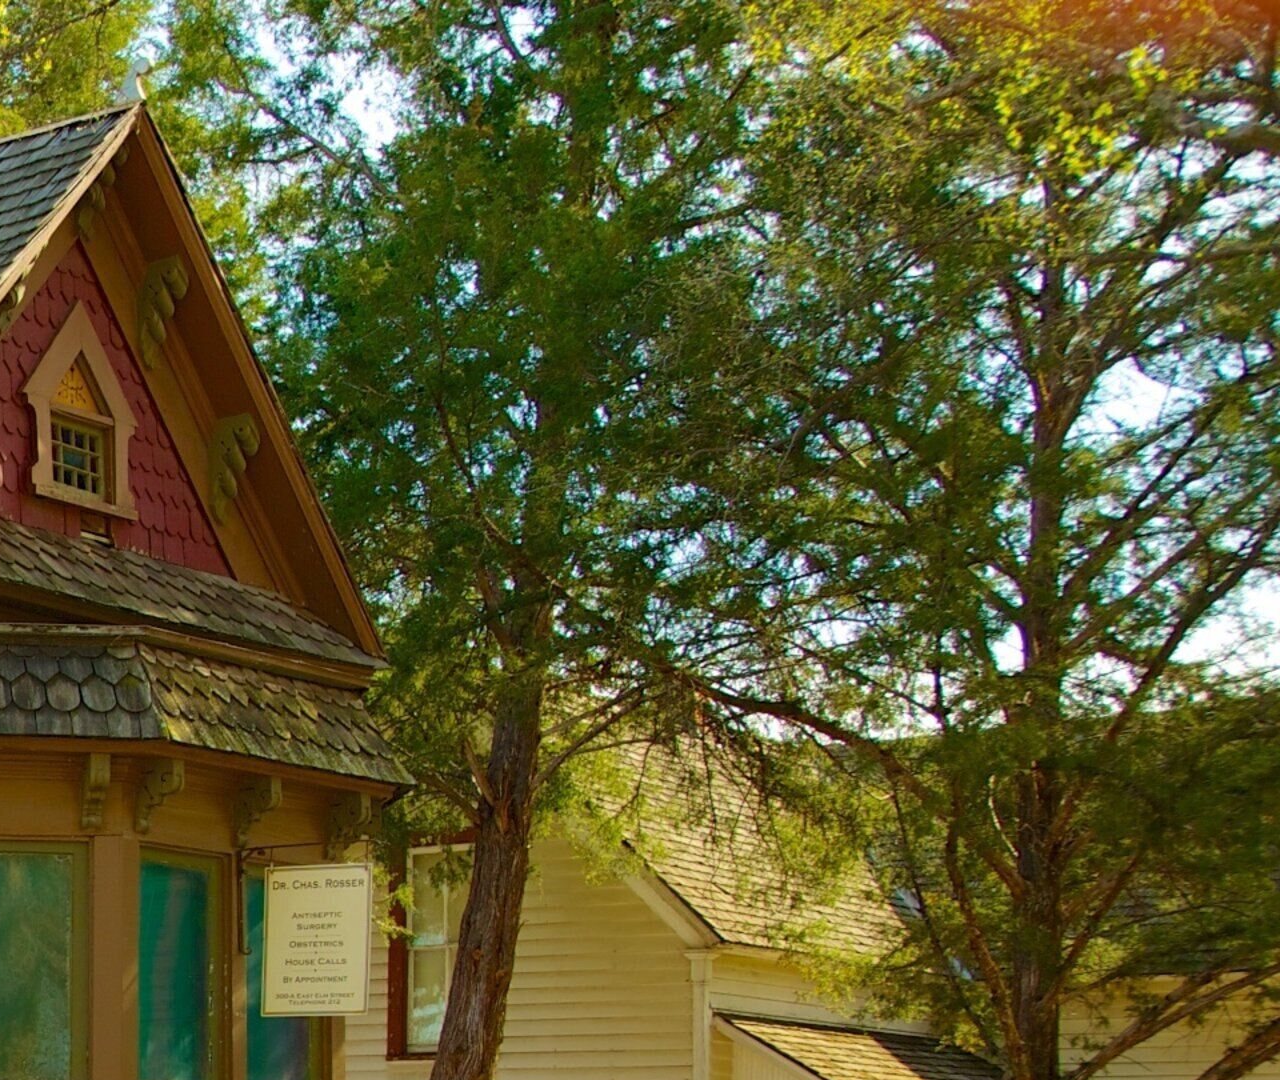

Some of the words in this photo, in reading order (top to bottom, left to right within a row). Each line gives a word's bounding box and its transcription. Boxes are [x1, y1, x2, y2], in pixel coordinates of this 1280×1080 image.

[272, 880, 290, 890] DR.
[293, 879, 321, 889] CHAS.
[325, 878, 365, 889] ROSSER
[291, 911, 343, 920] ANTISEPTIC
[296, 923, 338, 931] SURGERY
[289, 940, 344, 949] OBSTETRICS
[284, 958, 315, 966] HOUSE
[317, 957, 347, 965] CALLS
[283, 976, 293, 984] BY
[295, 975, 348, 983] APPOINTMENT
